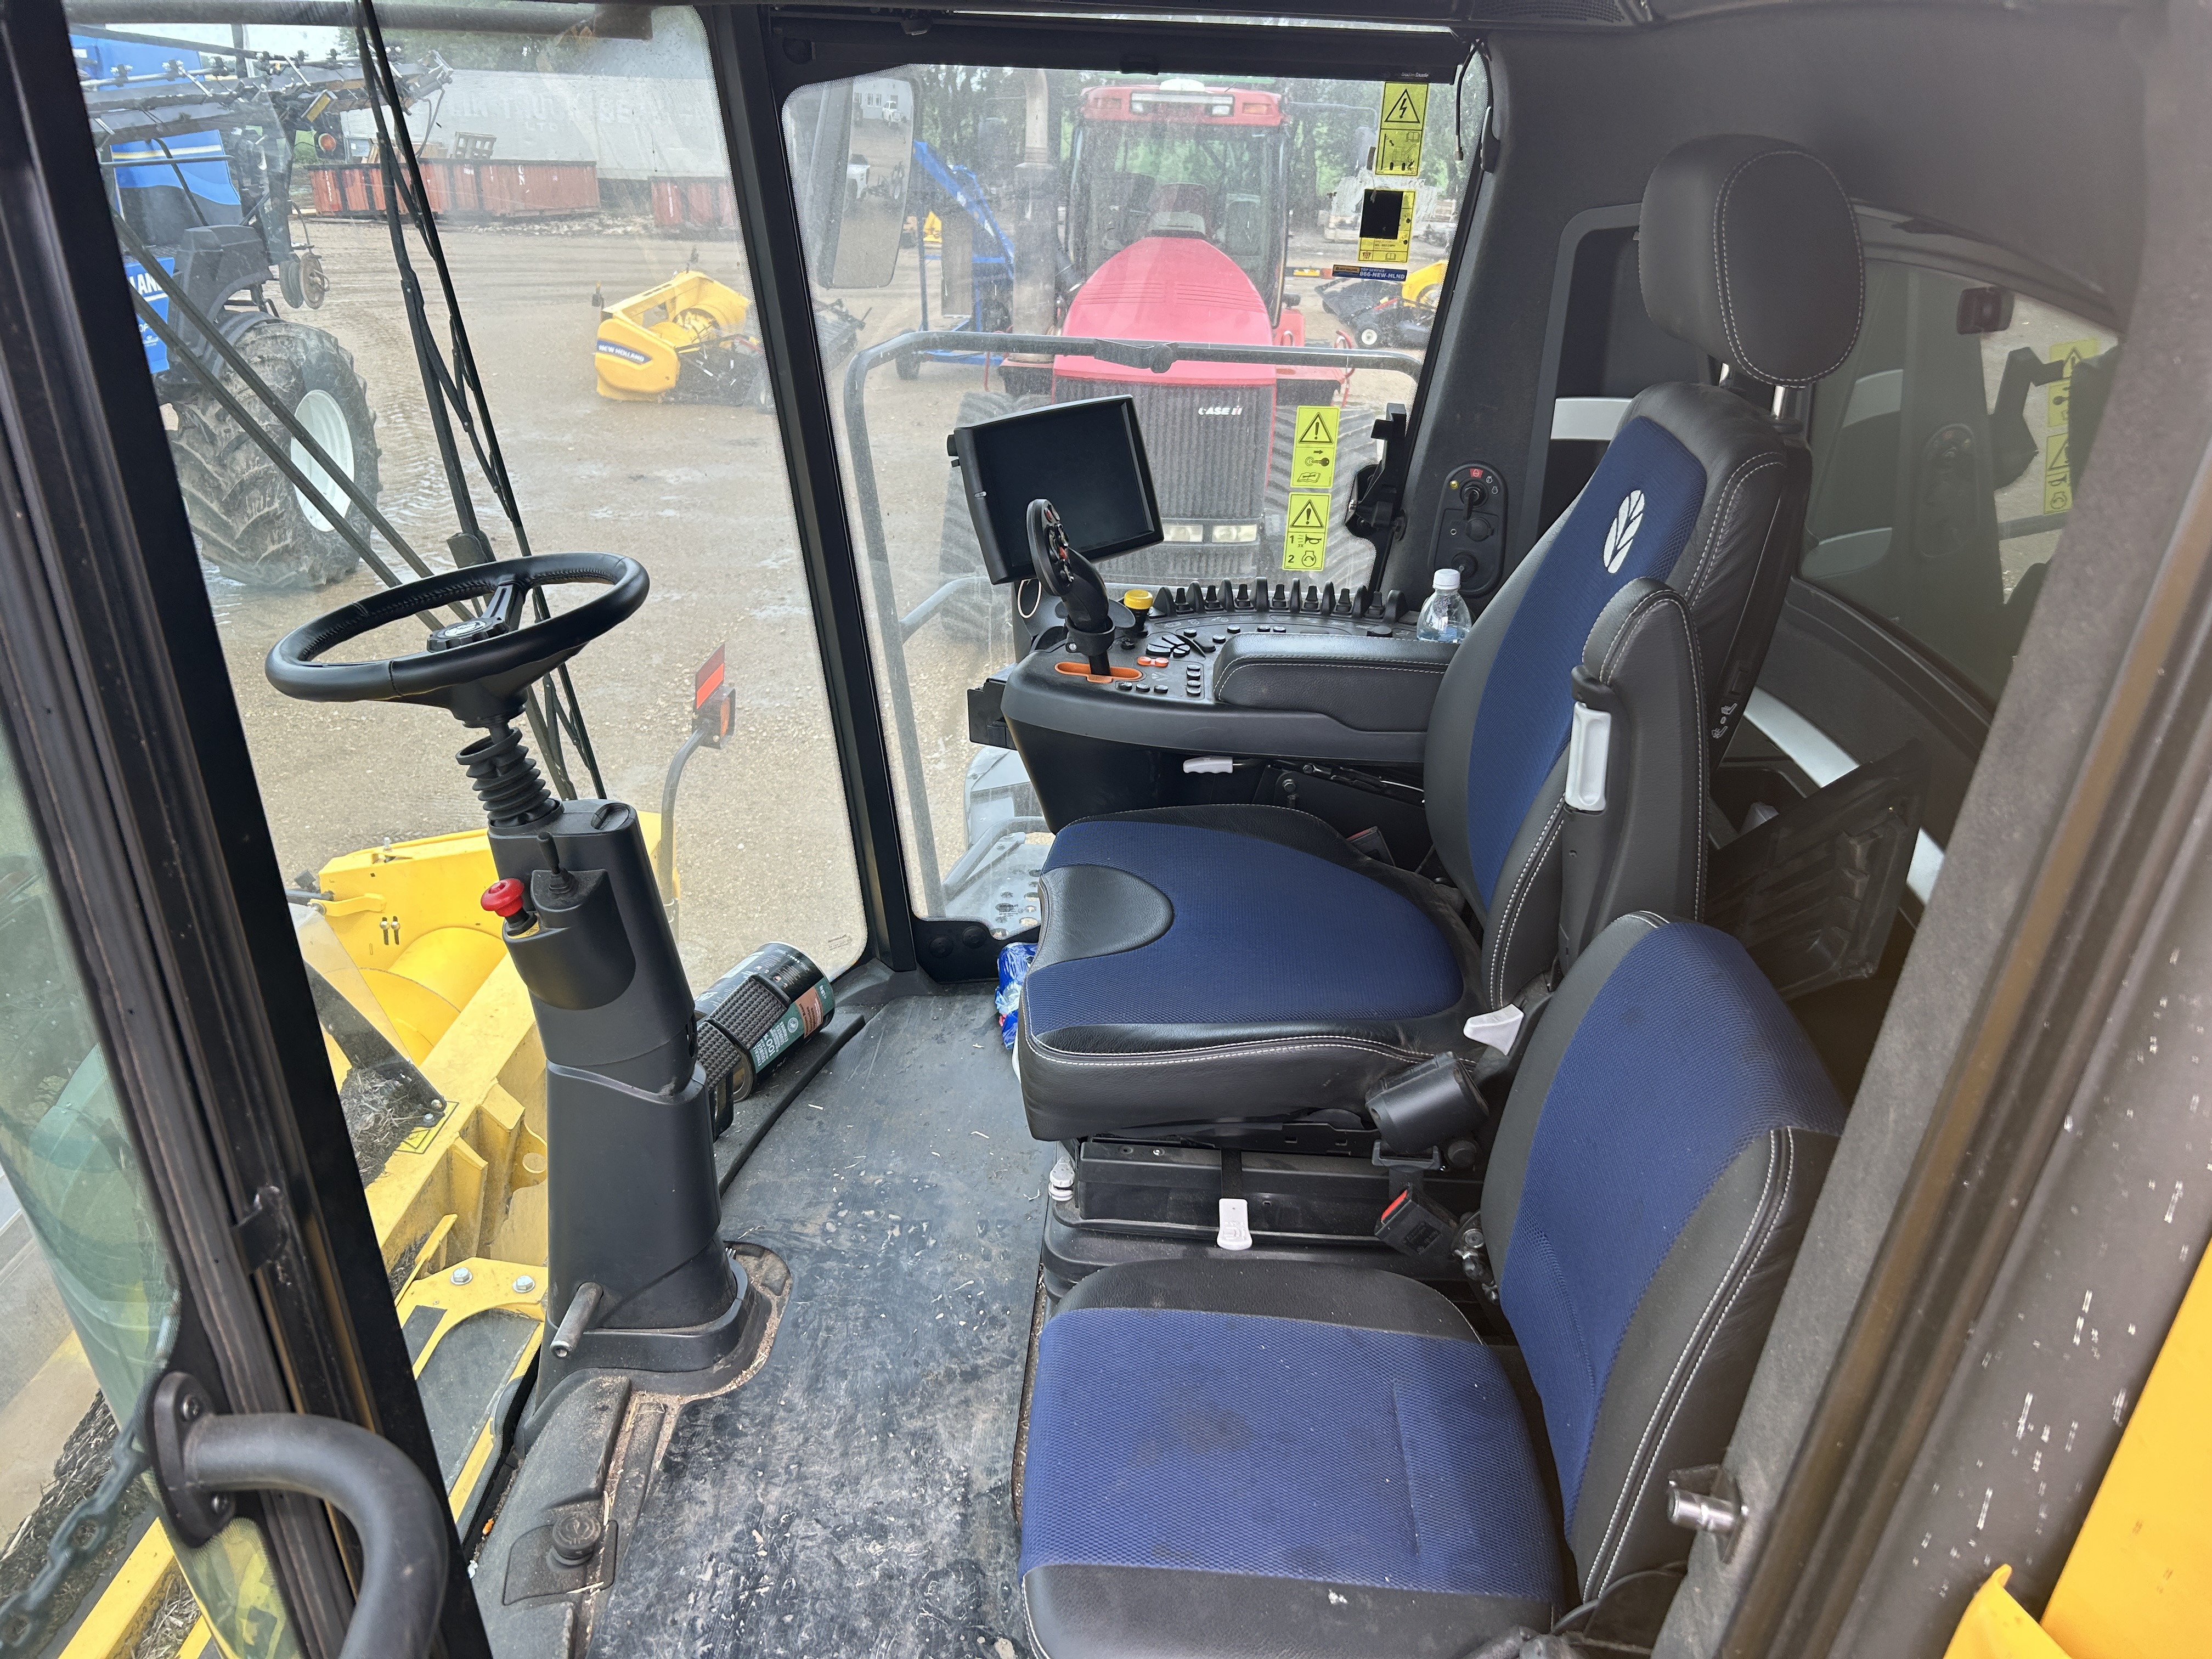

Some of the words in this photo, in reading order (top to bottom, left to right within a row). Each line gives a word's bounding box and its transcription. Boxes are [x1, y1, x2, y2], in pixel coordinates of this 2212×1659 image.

[599, 345, 615, 353] NEW
[615, 348, 645, 362] HOLLAND
[1198, 407, 1231, 415] CASE
[1290, 535, 1294, 544] 1
[1288, 555, 1295, 563] 2
